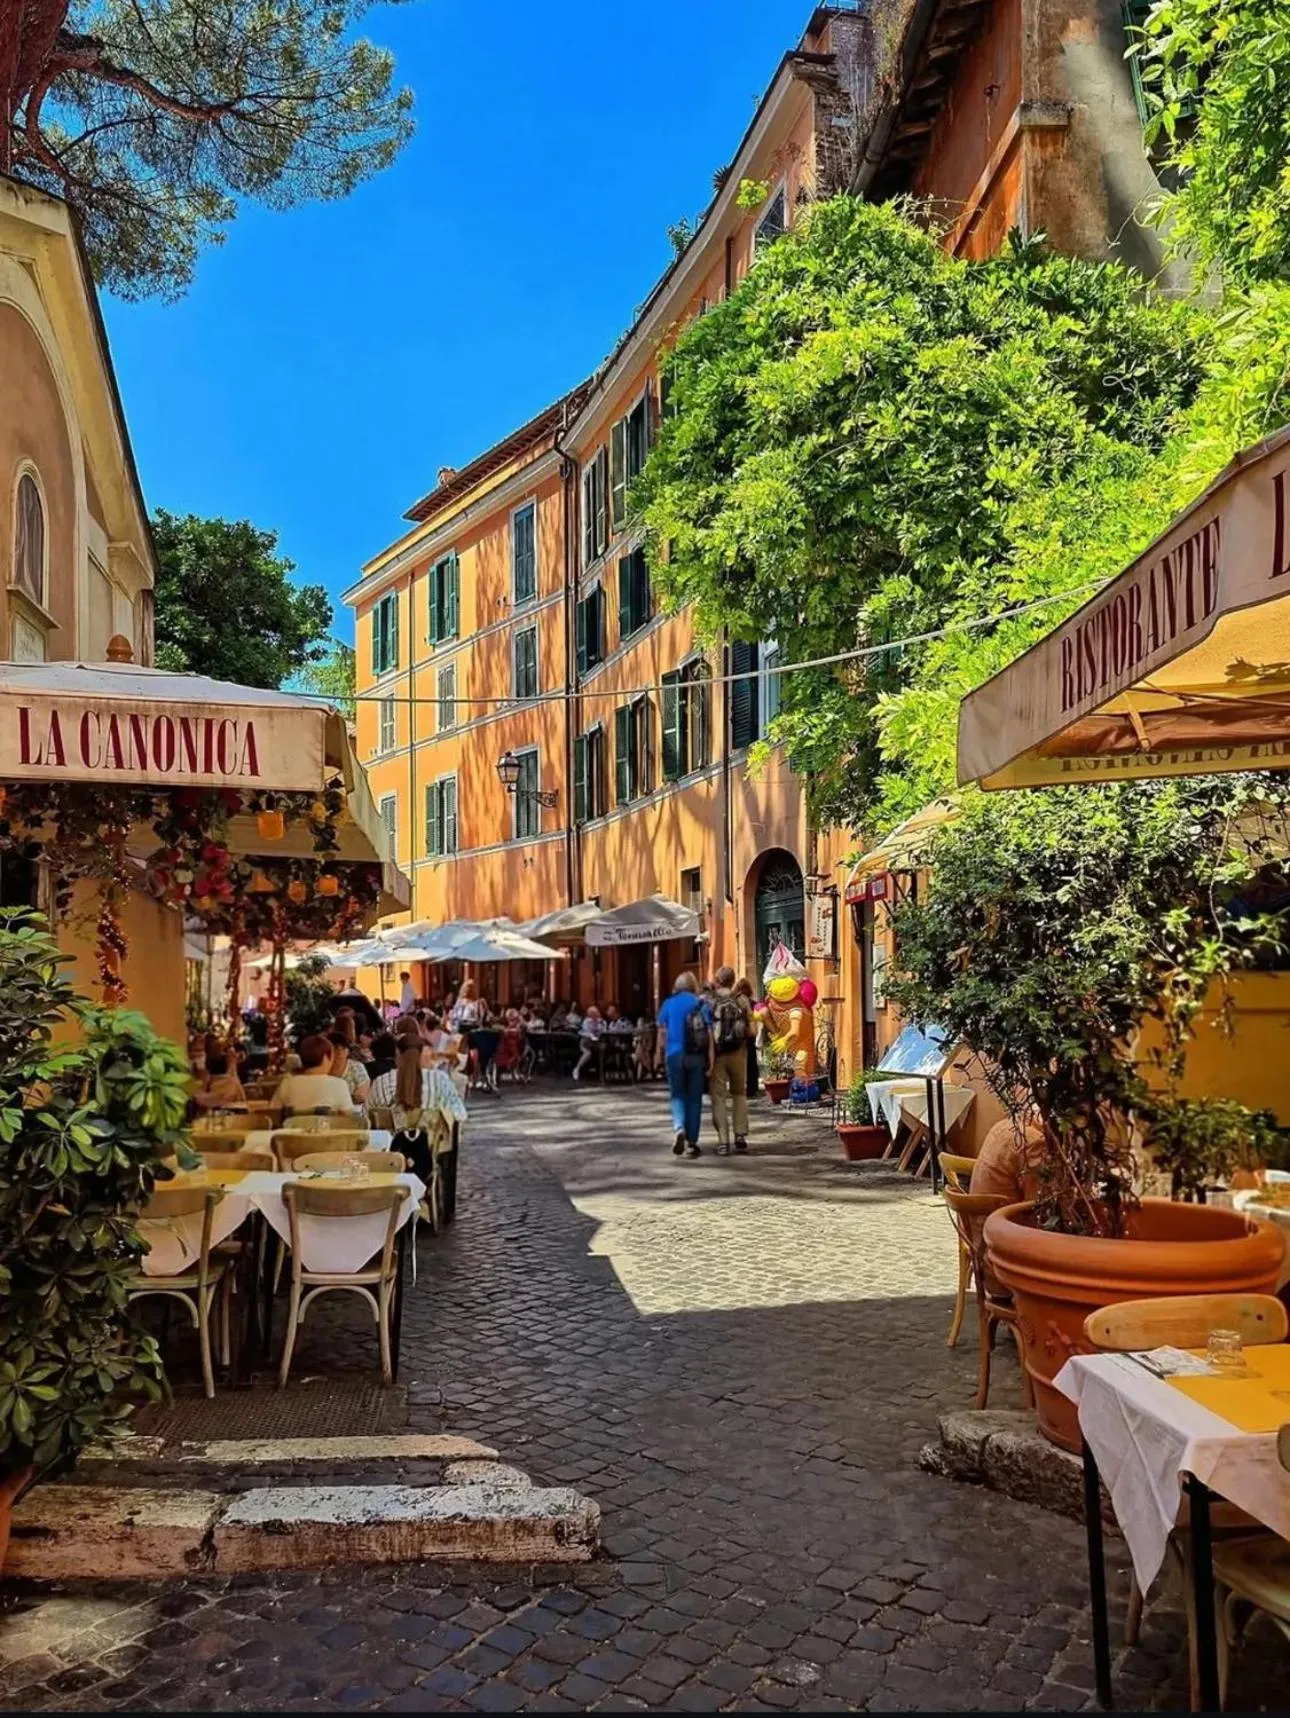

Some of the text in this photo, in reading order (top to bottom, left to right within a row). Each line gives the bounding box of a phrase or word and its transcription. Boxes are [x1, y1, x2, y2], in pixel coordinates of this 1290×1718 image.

[1060, 516, 1221, 714] RISTORANTE
[16, 706, 261, 777] LA CANONICA
